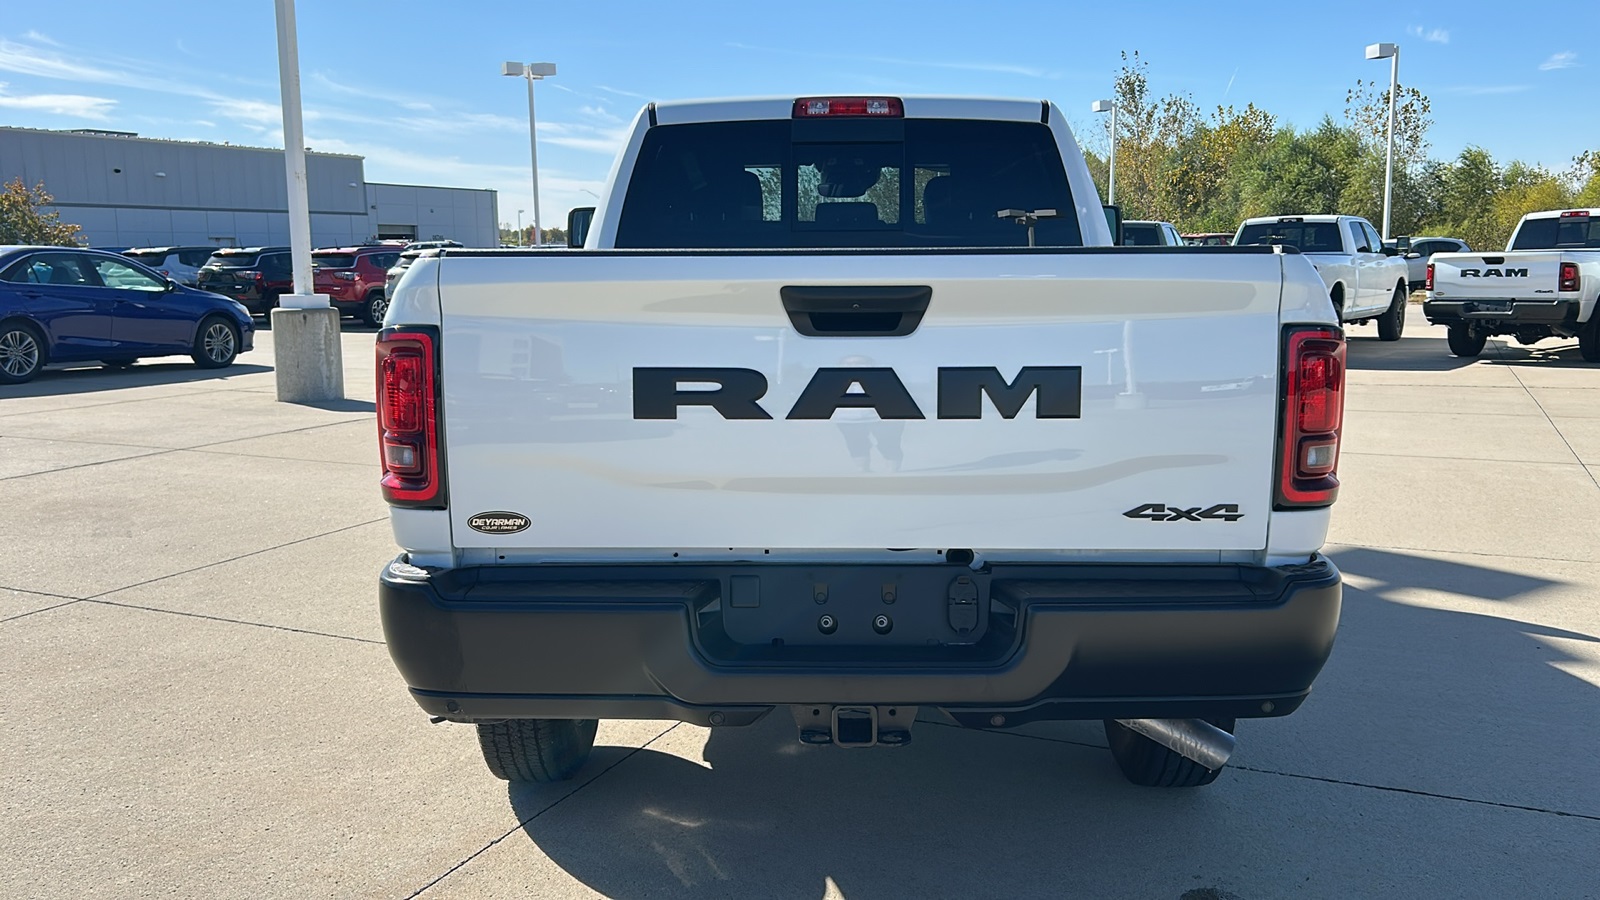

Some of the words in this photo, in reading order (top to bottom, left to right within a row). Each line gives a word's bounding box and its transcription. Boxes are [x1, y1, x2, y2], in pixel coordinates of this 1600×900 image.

[1460, 268, 1529, 278] RAM
[633, 366, 1082, 420] RAM
[1122, 503, 1245, 522] 4x4
[472, 518, 525, 526] DEYARMAN
